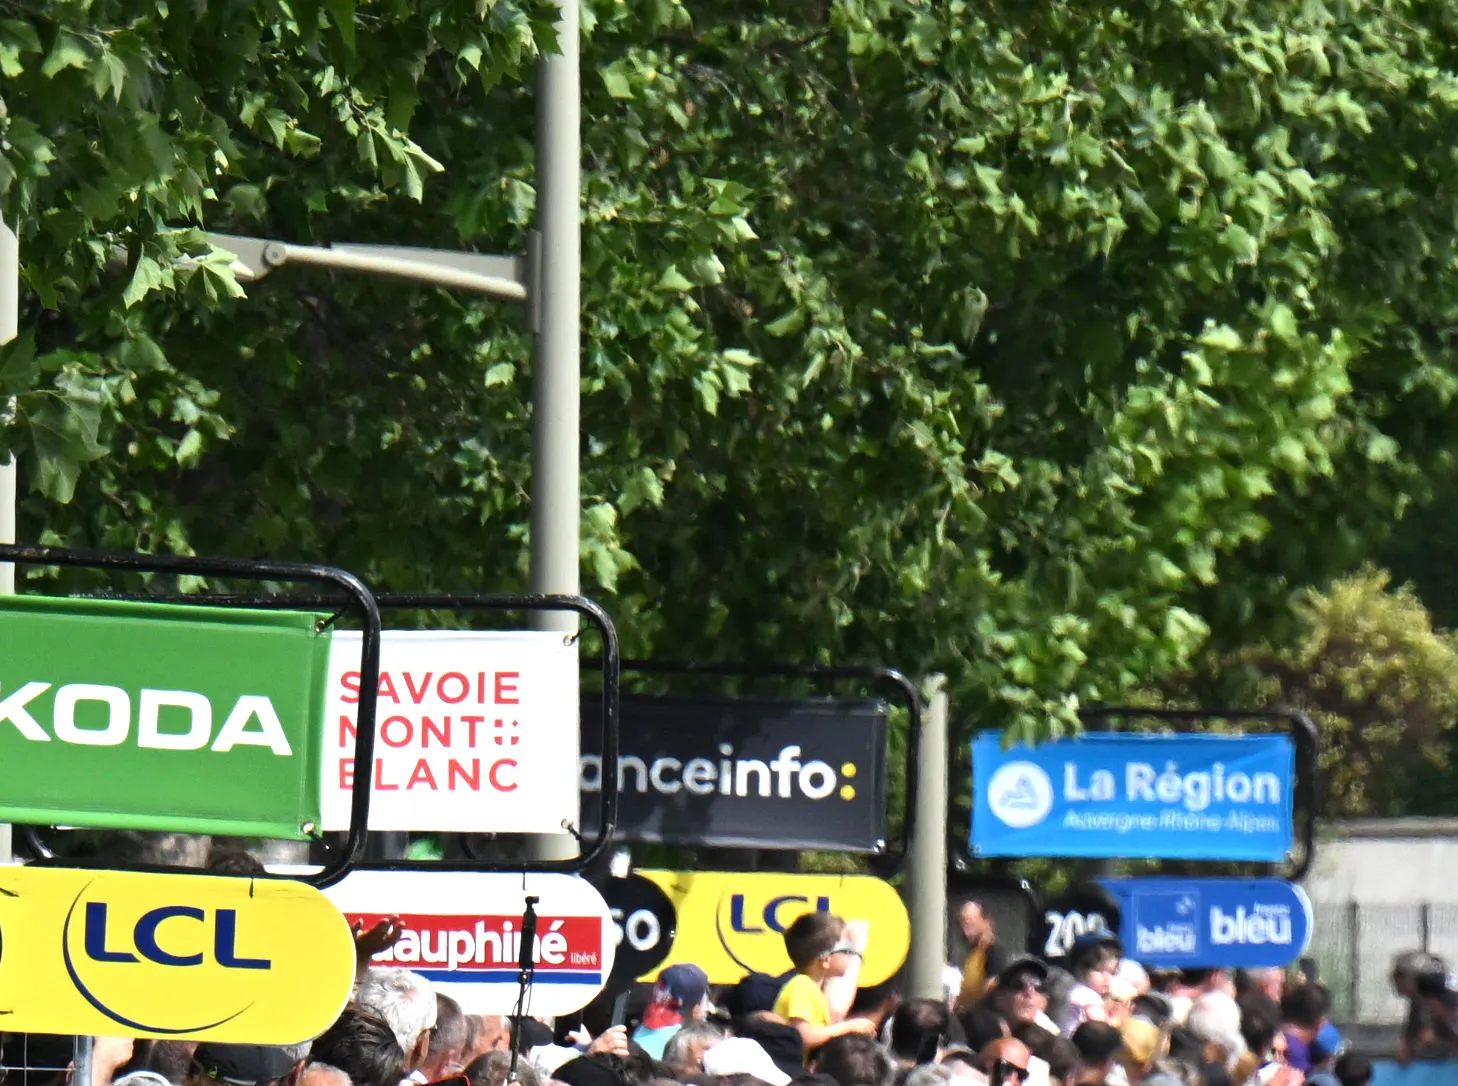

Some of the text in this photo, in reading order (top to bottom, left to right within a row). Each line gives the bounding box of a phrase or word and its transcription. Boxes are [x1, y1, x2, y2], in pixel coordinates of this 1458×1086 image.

[339, 671, 520, 704] SAVOIE
[339, 758, 518, 792] BLANC
[1064, 759, 1281, 812] La Région
[84, 902, 271, 970] LCL
[1210, 904, 1292, 944] bleu
[570, 951, 597, 966] libéré
